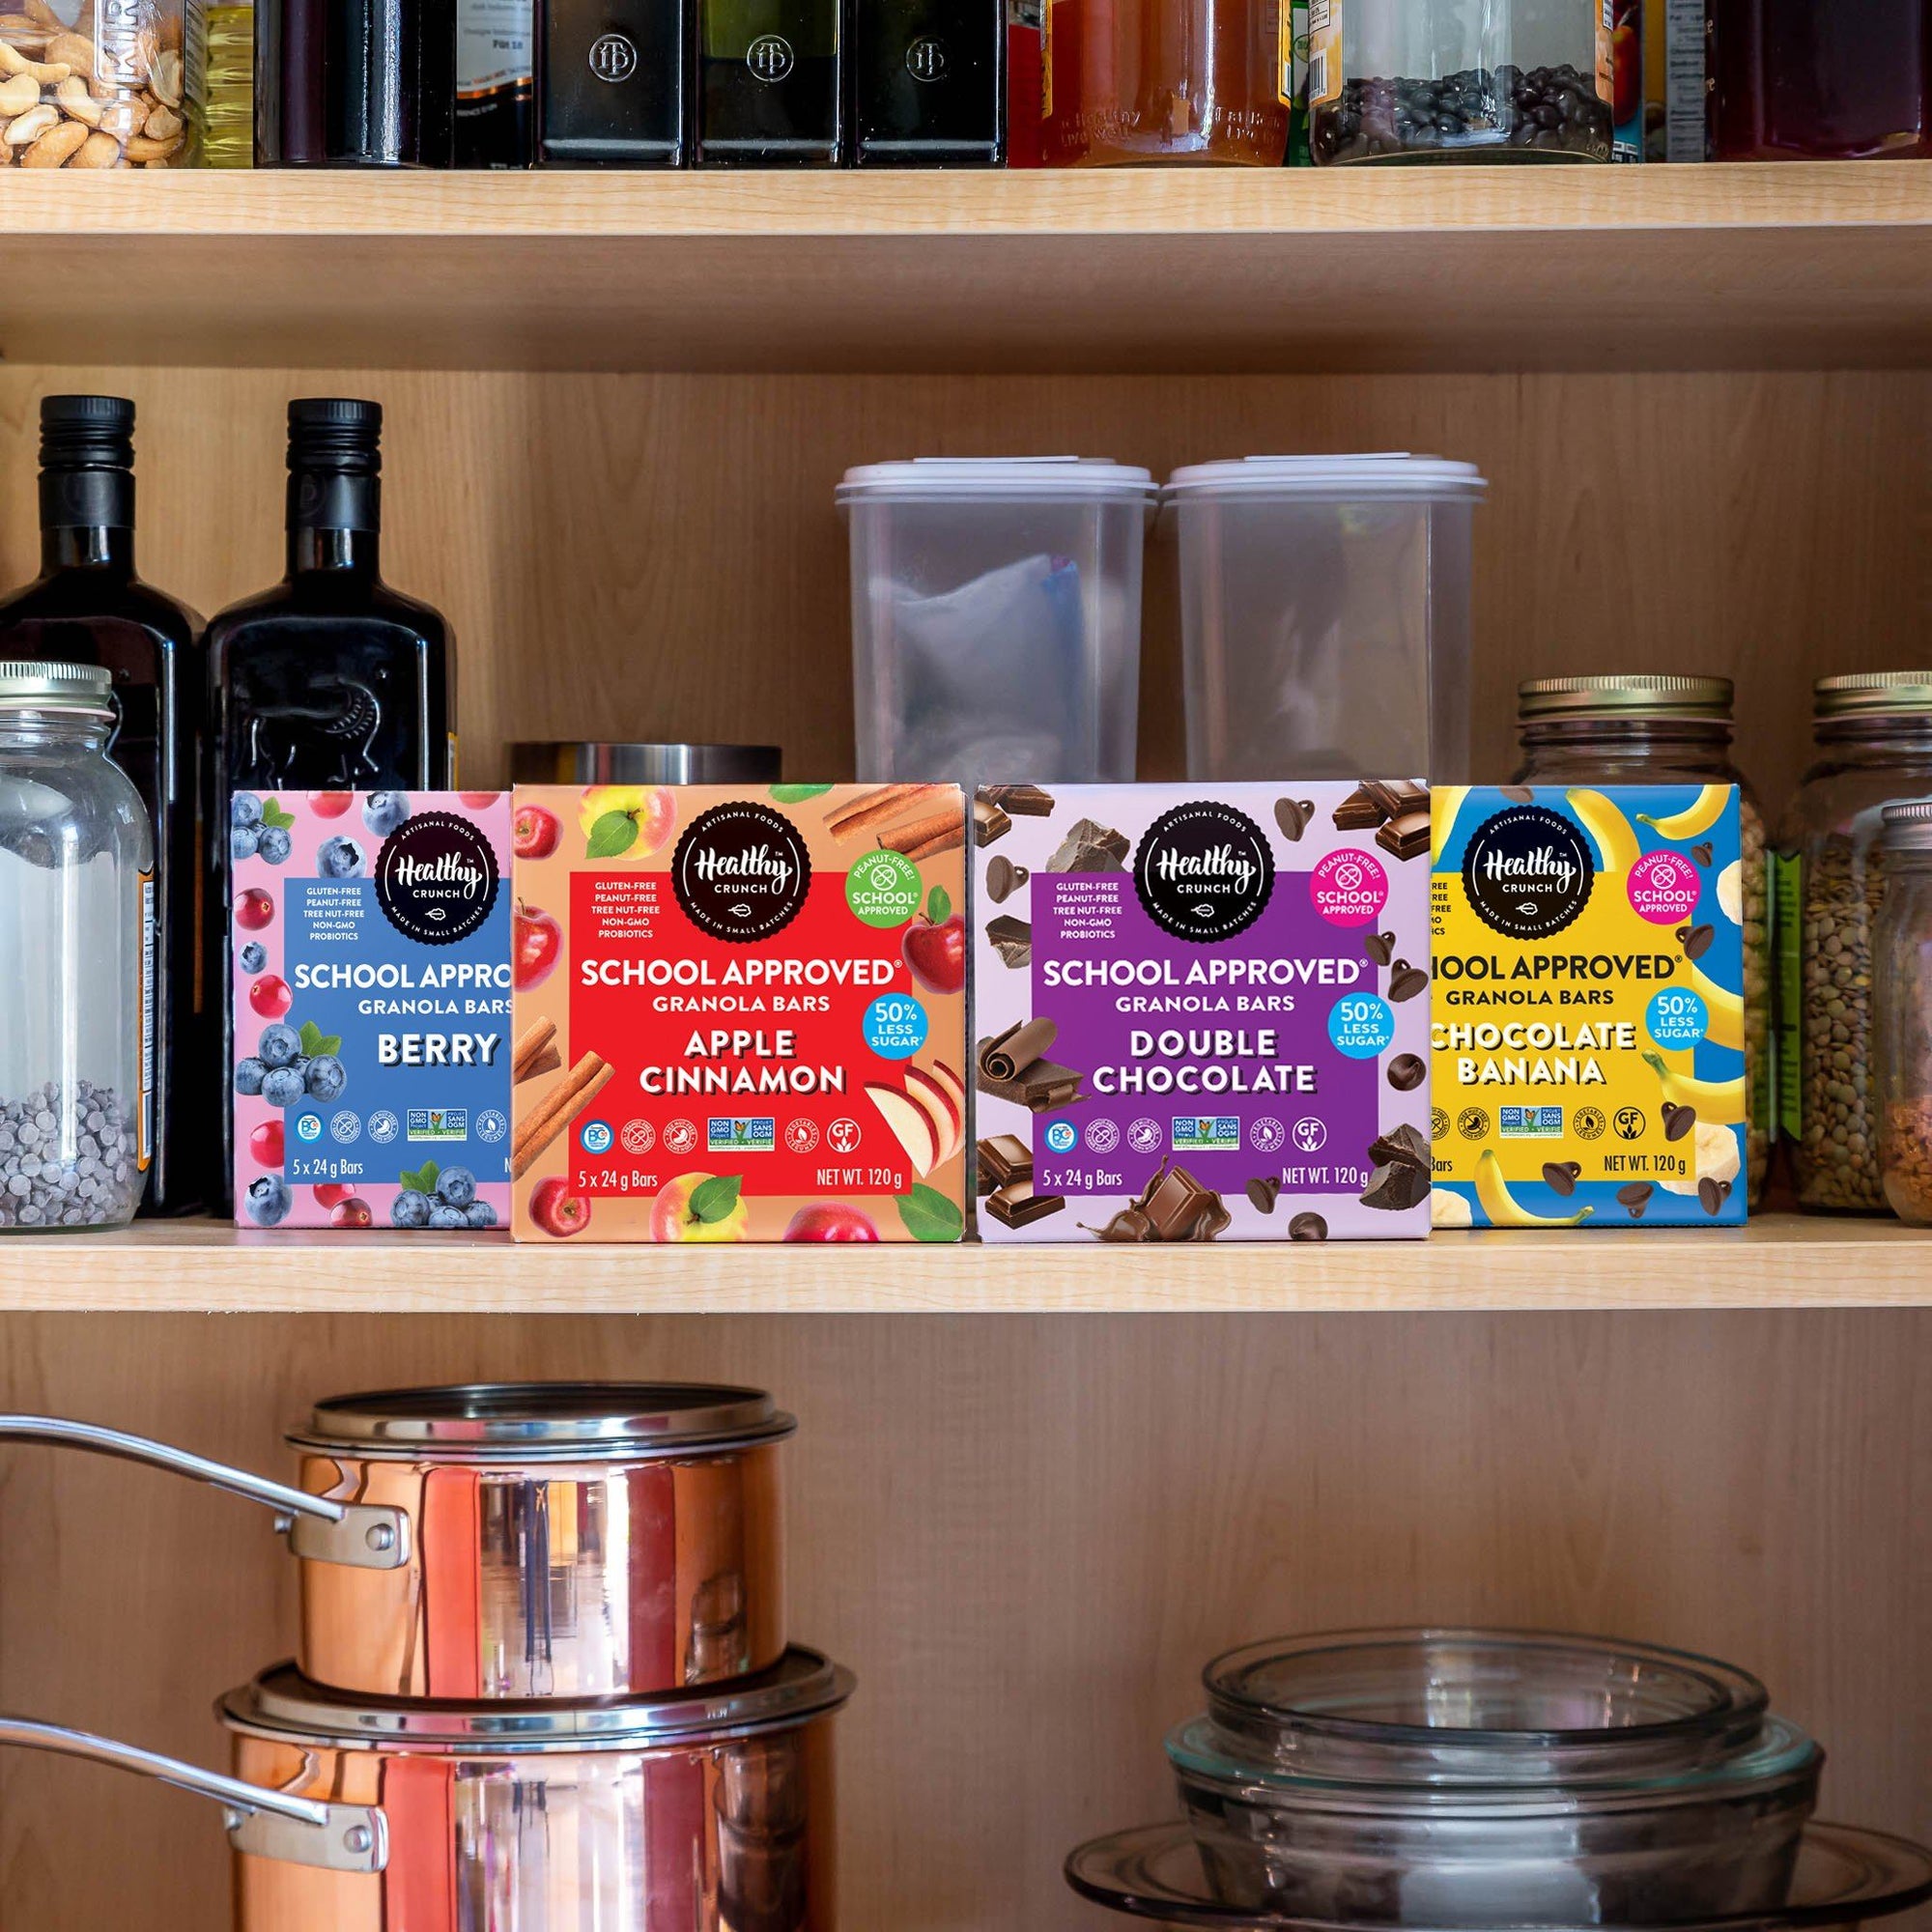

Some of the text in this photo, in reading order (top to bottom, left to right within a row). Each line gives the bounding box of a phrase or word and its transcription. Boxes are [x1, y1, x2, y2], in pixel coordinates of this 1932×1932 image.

[401, 820, 475, 841] ARTISANAL FOODS
[701, 811, 784, 833] ARTISANAL FOODS
[1163, 810, 1247, 833] ARTISANAL FOODS
[1489, 814, 1568, 835] ARTISANAL FOODS
[854, 855, 916, 881] PEANUT-FREE!
[1318, 853, 1380, 880] PEANUT-FREE!
[1634, 855, 1693, 880] PEANUT-FREE!
[306, 887, 361, 895] GLUTEN-FREE
[412, 889, 460, 898] CRUNCH
[595, 882, 657, 891] GLUTEN-FREE
[714, 884, 768, 894] CRUNCH
[1056, 882, 1119, 891] GLUTEN-FREE
[1177, 885, 1231, 894] CRUNCH
[1502, 884, 1552, 893] CRUNCH
[595, 894, 657, 902] PEANUT-FREE
[1056, 895, 1119, 903] PEANUT-FREE
[591, 906, 660, 915] TREE NUT-FREE
[690, 902, 710, 923] MADE
[712, 922, 724, 930] IN
[759, 901, 793, 930] BATCHES
[858, 906, 908, 916] APPROVED
[1053, 906, 1122, 915] TREE NUT-FREE
[1152, 902, 1174, 924] MADE
[1175, 922, 1186, 930] IN
[1223, 901, 1257, 930] BATCHES
[1322, 905, 1374, 915] APPROVED
[1480, 900, 1499, 922] MADE
[1501, 919, 1511, 927] IN
[1546, 900, 1577, 928] BATCHES
[1639, 903, 1688, 913] APPROVED
[390, 905, 411, 926] MADE
[412, 924, 421, 933] IN
[452, 905, 483, 933] BATCHES
[602, 918, 650, 926] NON-GMO
[1064, 919, 1112, 927] NON-GMO
[310, 932, 358, 941] PROBIOTICS
[599, 929, 653, 939] PROBIOTICS
[1060, 930, 1116, 939] PROBIOTICS
[295, 963, 413, 989] SCHOOL
[581, 959, 716, 985] SCHOOL
[1043, 959, 1179, 986] SCHOOL
[358, 999, 459, 1015] GRANOLA
[652, 996, 830, 1012] GRANOLA BARS
[1115, 995, 1295, 1012] GRANOLA BARS
[1446, 990, 1614, 1005] GRANOLA BARS
[1658, 996, 1698, 1015] 50%
[875, 1002, 917, 1022] 50%
[1341, 1002, 1383, 1023] 50%
[878, 1024, 913, 1035] LESS
[1344, 1024, 1379, 1035] LESS
[1660, 1017, 1693, 1027] LESS
[684, 1030, 796, 1059] APPLE
[1131, 1030, 1279, 1059] DOUBLE
[1432, 1022, 1636, 1050] CHOCOLATE
[378, 1034, 500, 1065] BERRY
[639, 1065, 845, 1094] CINNAMON
[1093, 1065, 1318, 1095] CHOCOLATE
[1458, 1058, 1606, 1085] BANANA
[1618, 1112, 1638, 1124] GF
[832, 1123, 853, 1137] GF
[1297, 1122, 1319, 1135] GF
[293, 1158, 363, 1179] 5 x 24 g Bars
[1605, 1155, 1686, 1175] NET WT. 120 g
[579, 1171, 658, 1191] 5 x 24 g Bars
[816, 1168, 902, 1189] NET WT. 120 g
[1043, 1170, 1122, 1190] 5 x 24 g Bars
[1282, 1167, 1369, 1187] NET WT. 120 g
